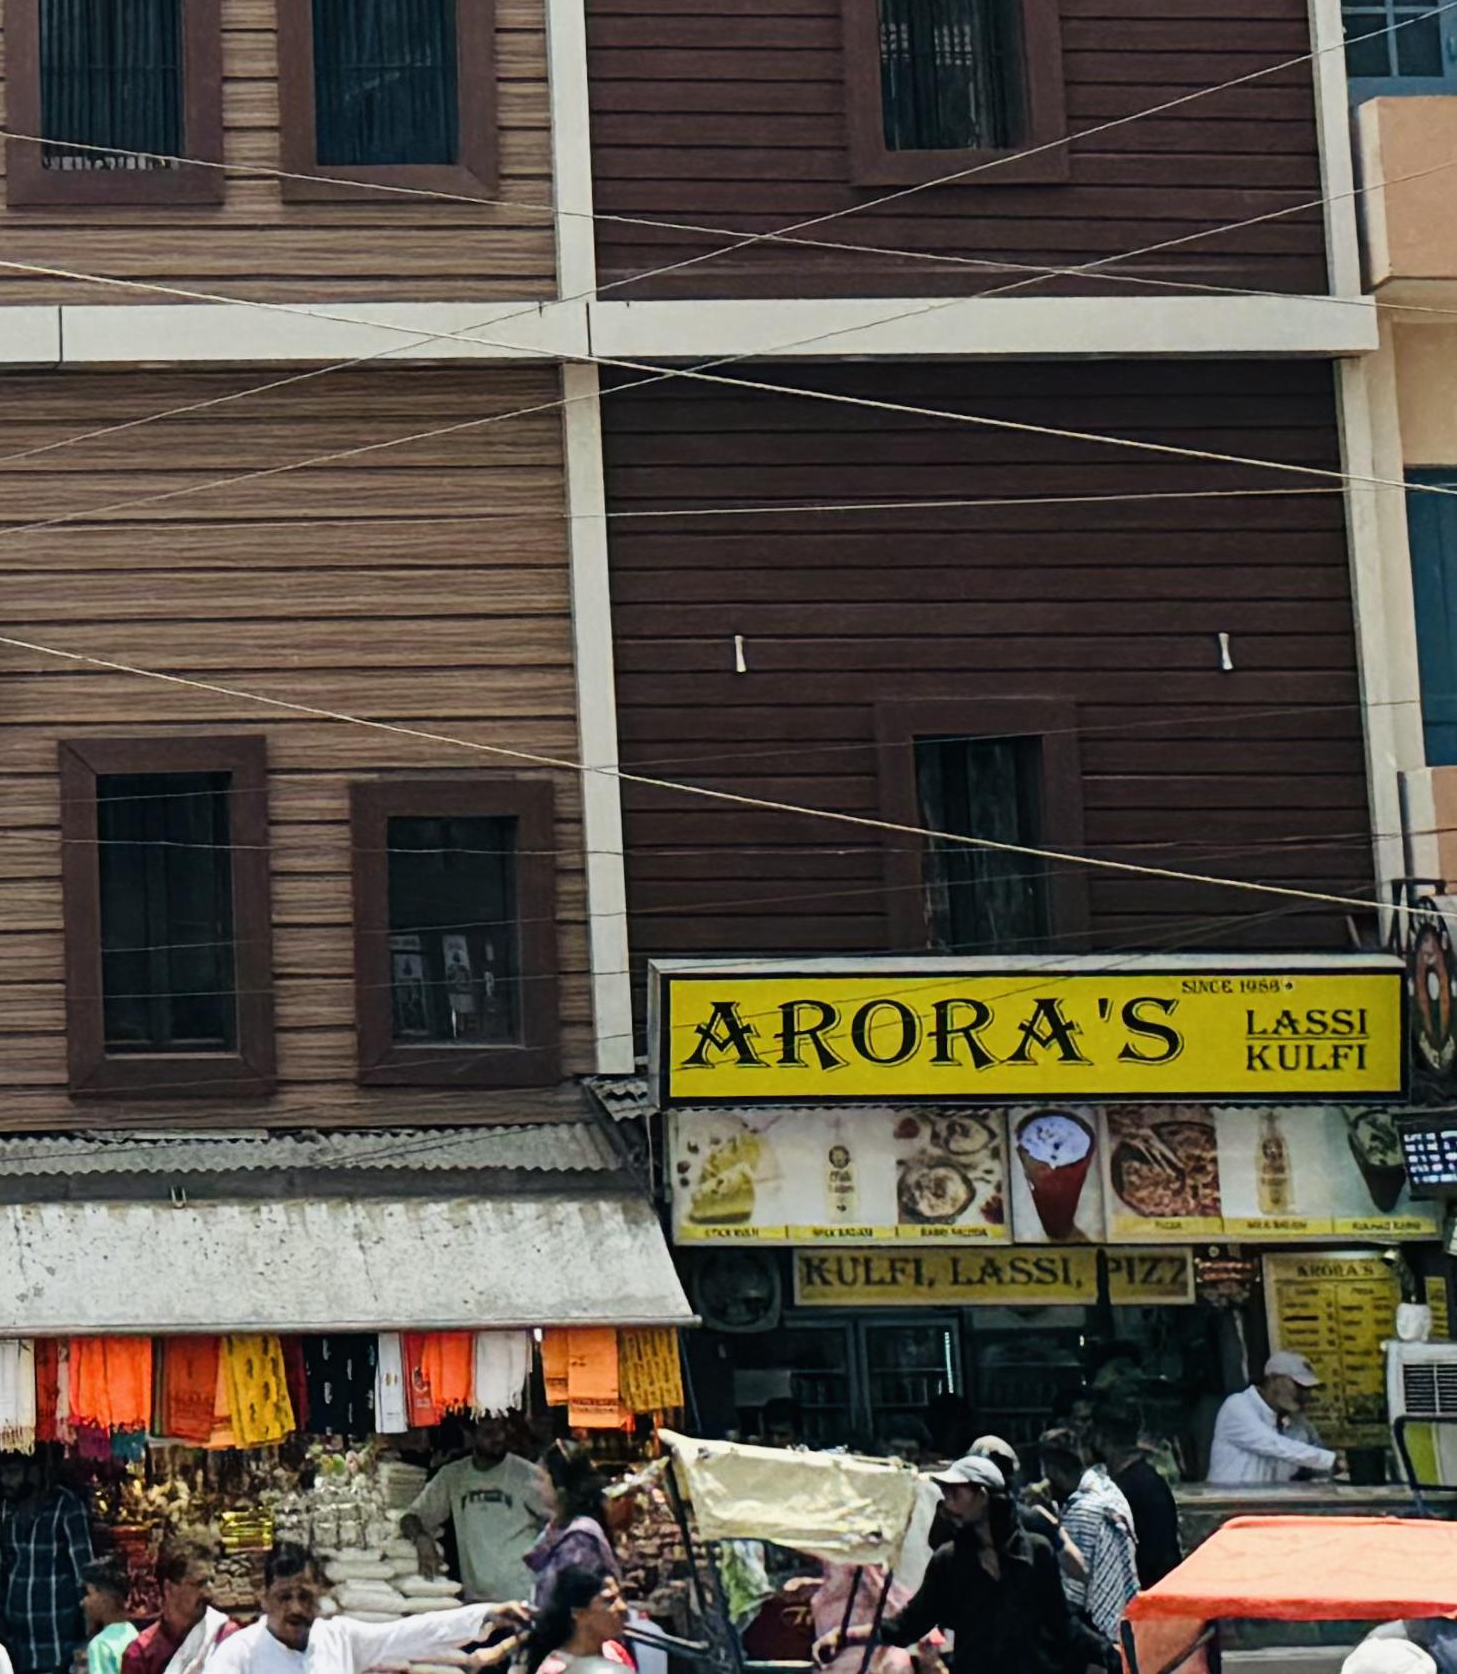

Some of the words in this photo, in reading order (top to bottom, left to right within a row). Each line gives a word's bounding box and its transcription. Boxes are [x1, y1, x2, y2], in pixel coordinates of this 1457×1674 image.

[1181, 979, 1234, 994] SINCE
[679, 997, 1184, 1072] ARORA'S
[1245, 1008, 1369, 1035] LASSI
[1245, 1044, 1368, 1071] KULFI
[802, 1255, 936, 1288] KULFI,
[950, 1255, 1082, 1289] LASSI,
